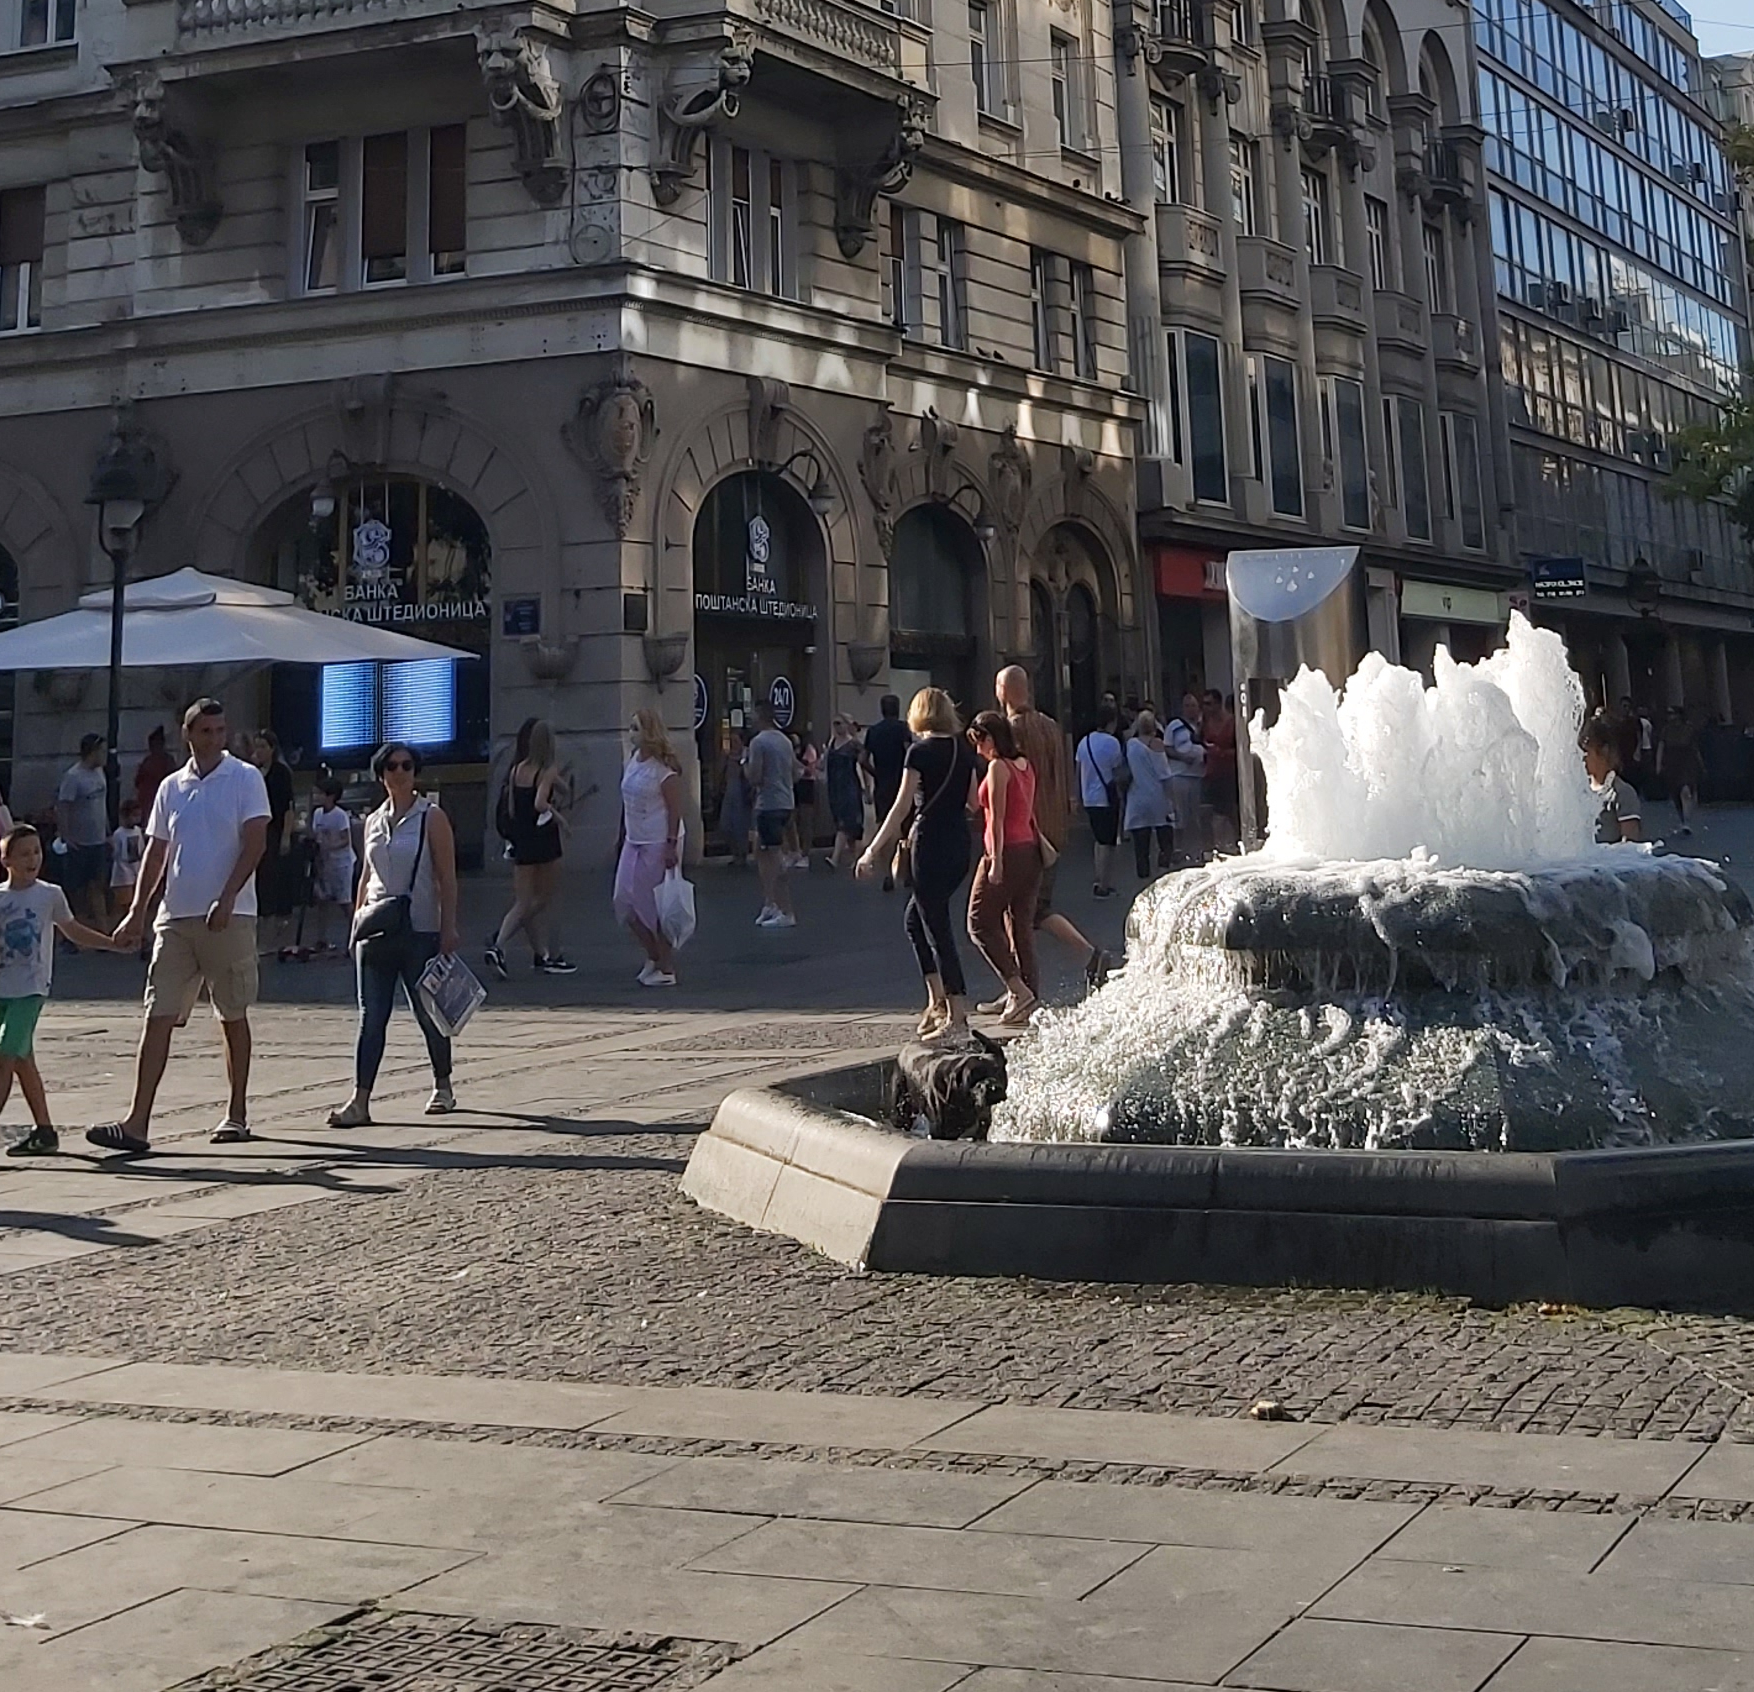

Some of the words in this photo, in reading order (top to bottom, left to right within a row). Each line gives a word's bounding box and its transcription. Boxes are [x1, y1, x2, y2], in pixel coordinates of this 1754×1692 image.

[345, 584, 399, 601] БАНКА
[746, 576, 777, 595] БАНКА
[367, 601, 487, 622] ШТЕДИОНИЦА
[695, 593, 758, 613] ПОШТАНСКА
[759, 598, 818, 619] ШТЕДИОНИЦА
[774, 687, 789, 707] 24/7
